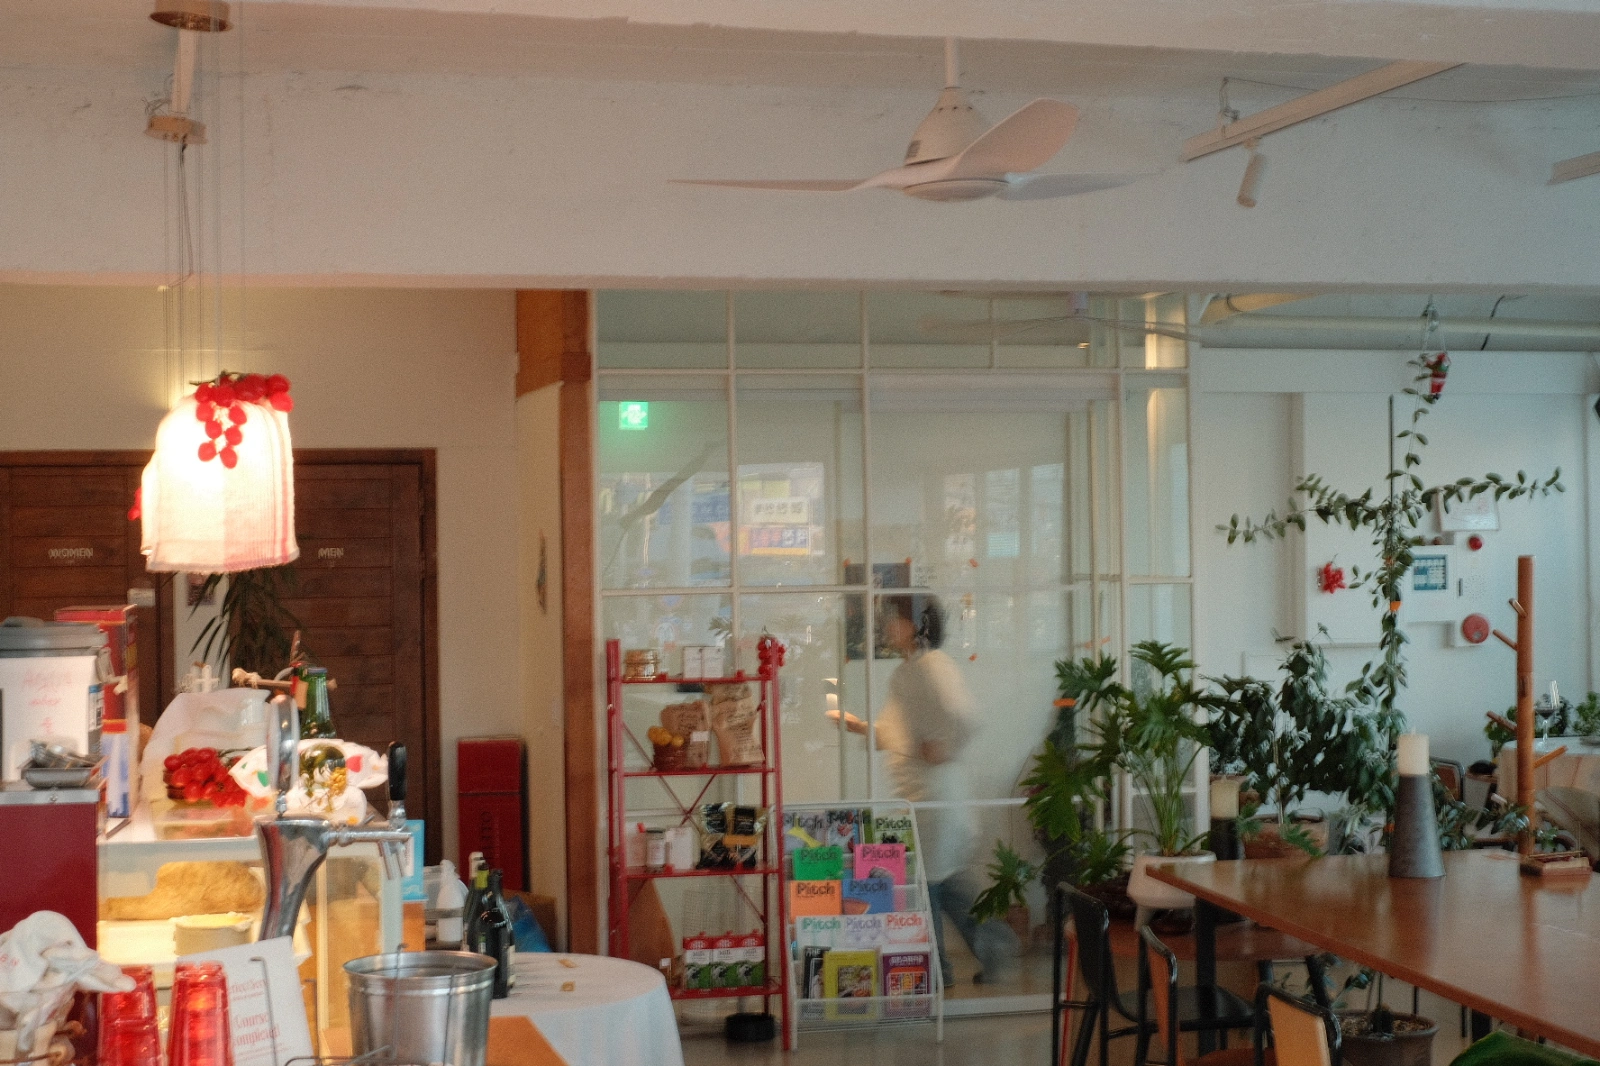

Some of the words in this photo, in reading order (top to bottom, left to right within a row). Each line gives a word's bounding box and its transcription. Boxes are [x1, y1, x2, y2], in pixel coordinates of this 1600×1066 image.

[48, 548, 94, 559] WOMEN
[317, 547, 344, 559] MEN
[876, 815, 913, 829] Pitch
[862, 846, 900, 860] Pitch
[797, 881, 835, 895] Pitch
[849, 879, 888, 893] Pitch
[802, 917, 841, 930] Pitch
[846, 917, 882, 929] Pitch
[886, 914, 922, 926] Pitch
[231, 1024, 280, 1046] ompleted
